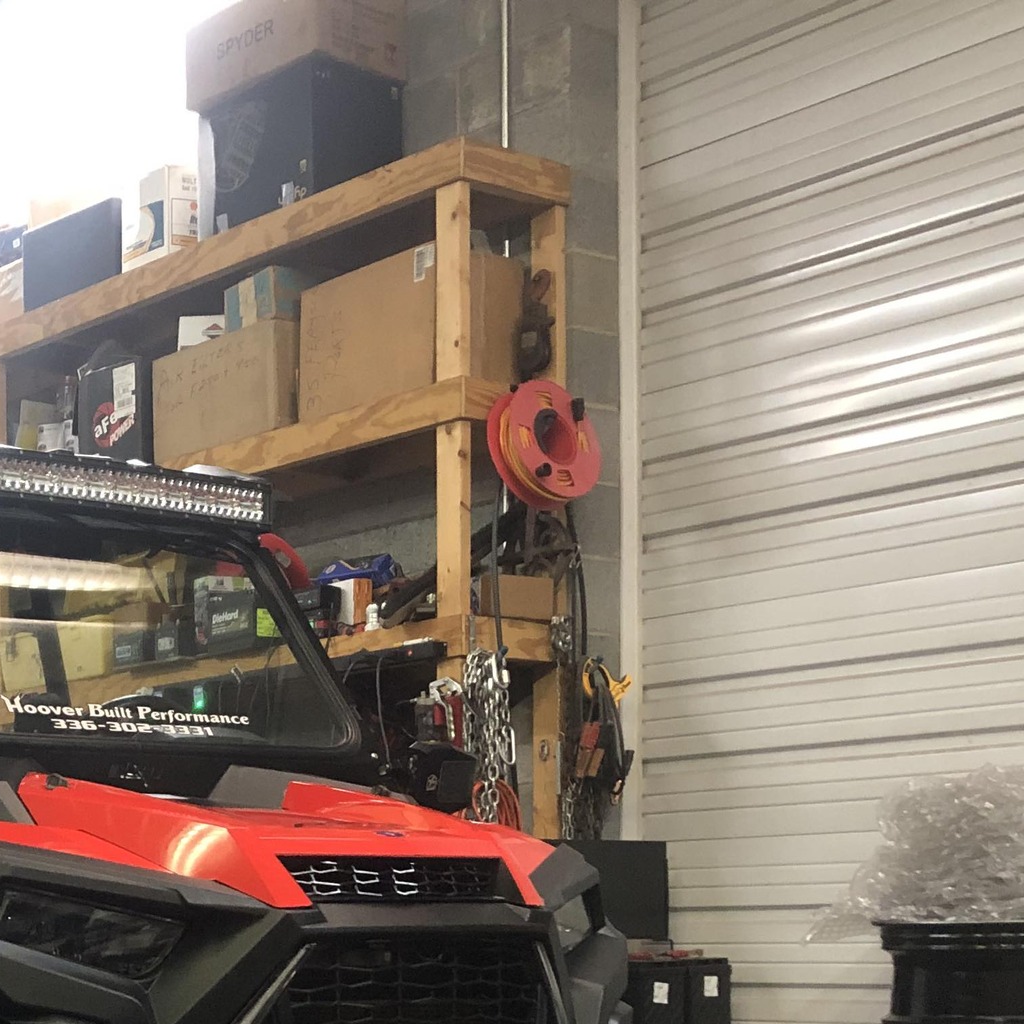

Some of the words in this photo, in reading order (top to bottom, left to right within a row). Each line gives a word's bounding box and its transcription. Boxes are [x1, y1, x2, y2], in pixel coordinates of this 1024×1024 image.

[216, 19, 274, 60] SPYDER
[93, 411, 118, 438] aFe
[109, 413, 136, 446] POWER
[211, 609, 239, 624] DieHard
[88, 703, 132, 719] Built
[137, 705, 250, 725] Performance
[50, 718, 215, 737] 336-302-3331
